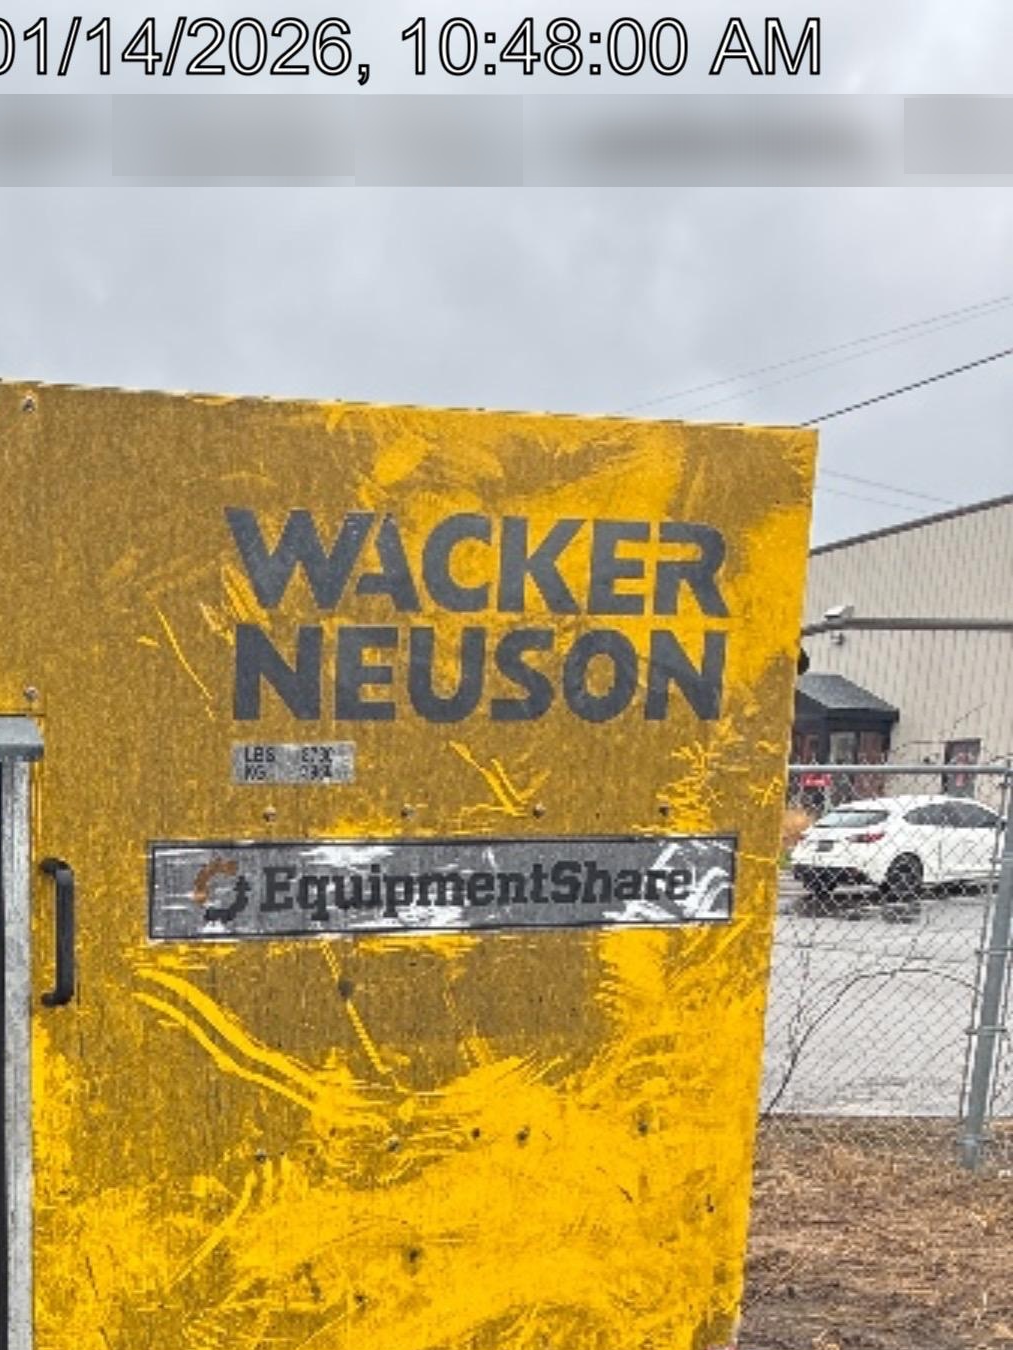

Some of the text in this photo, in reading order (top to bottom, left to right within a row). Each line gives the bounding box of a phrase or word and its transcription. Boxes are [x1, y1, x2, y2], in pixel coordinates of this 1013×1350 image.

[224, 507, 731, 618] WACKER
[231, 622, 728, 725] NEUSON
[244, 746, 276, 762] LBS
[260, 860, 691, 920] EquipmentShare
